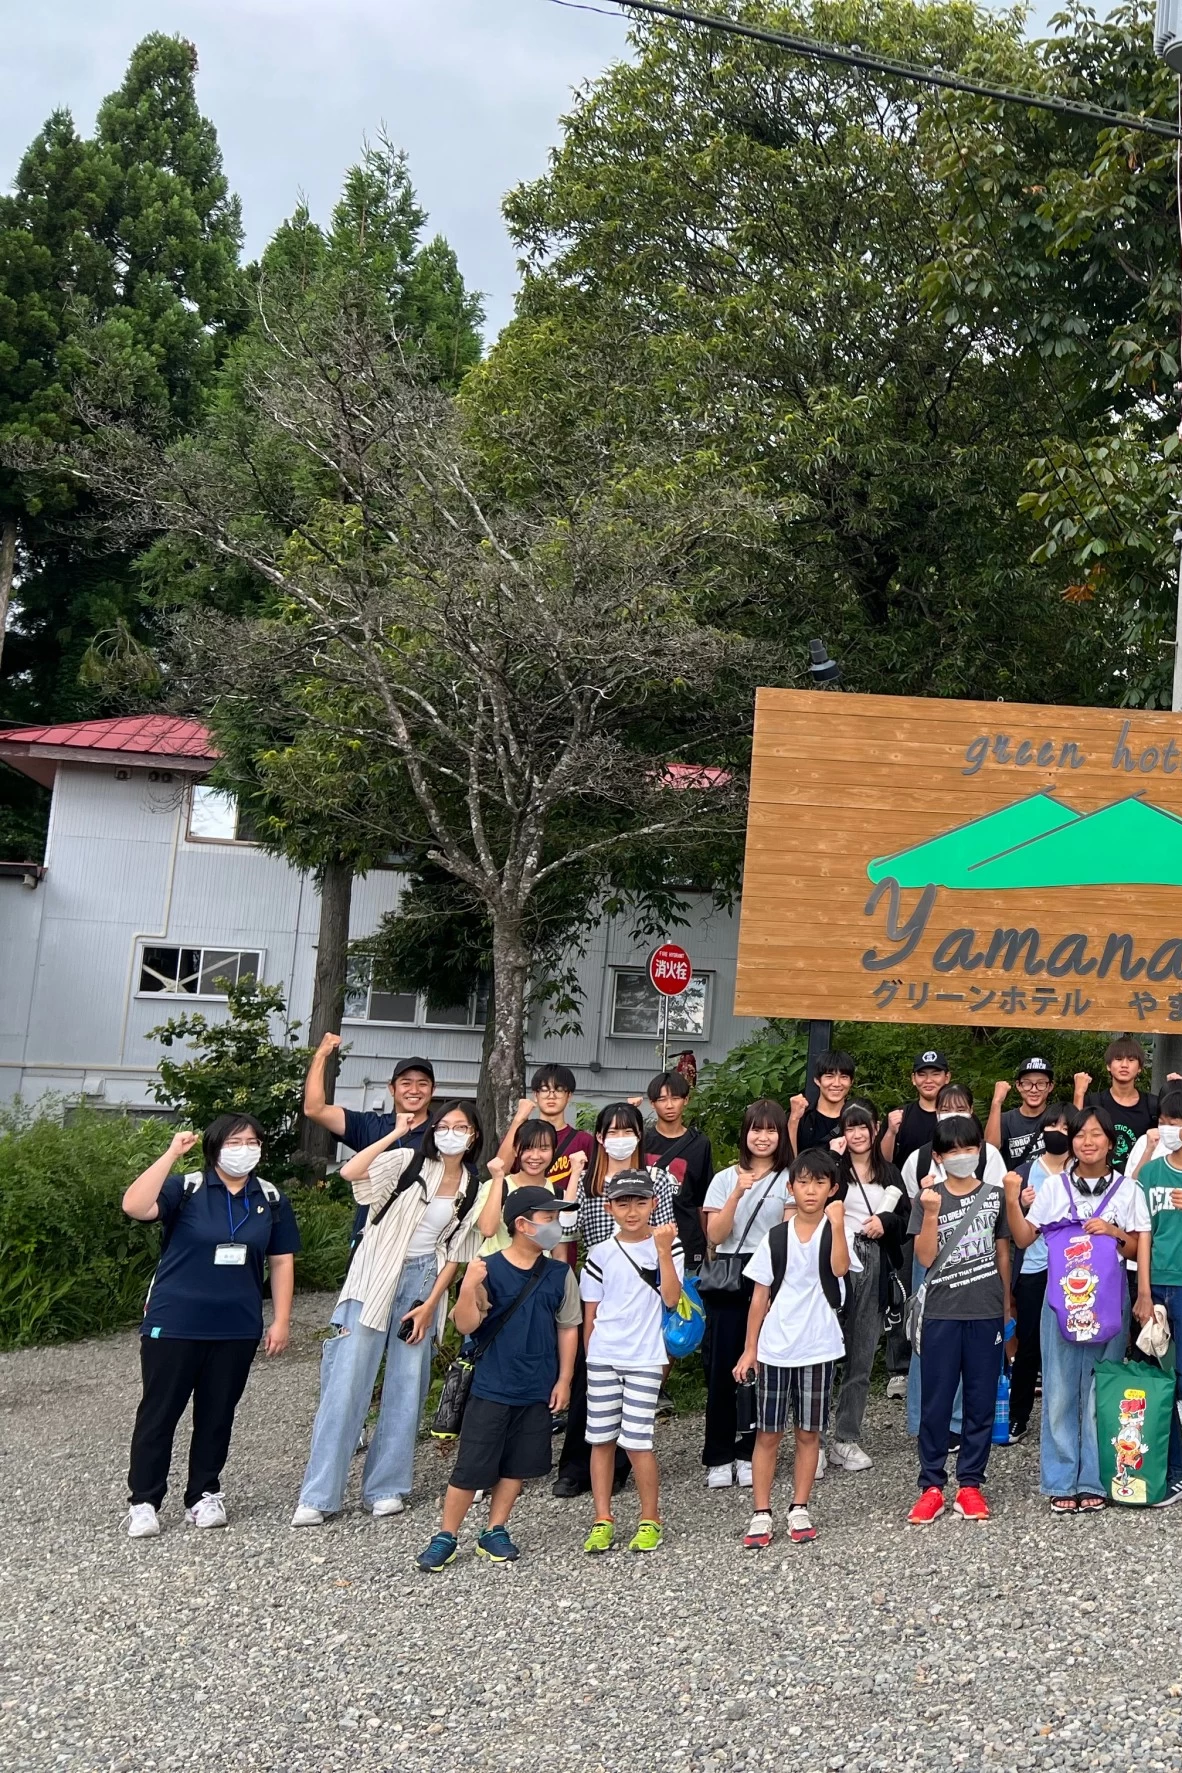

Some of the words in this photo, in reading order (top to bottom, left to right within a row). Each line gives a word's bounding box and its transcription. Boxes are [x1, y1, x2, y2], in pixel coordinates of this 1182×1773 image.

[961, 732, 1087, 776] green
[655, 959, 687, 980] 消火栓
[872, 979, 1091, 1016] グリーンホテル
